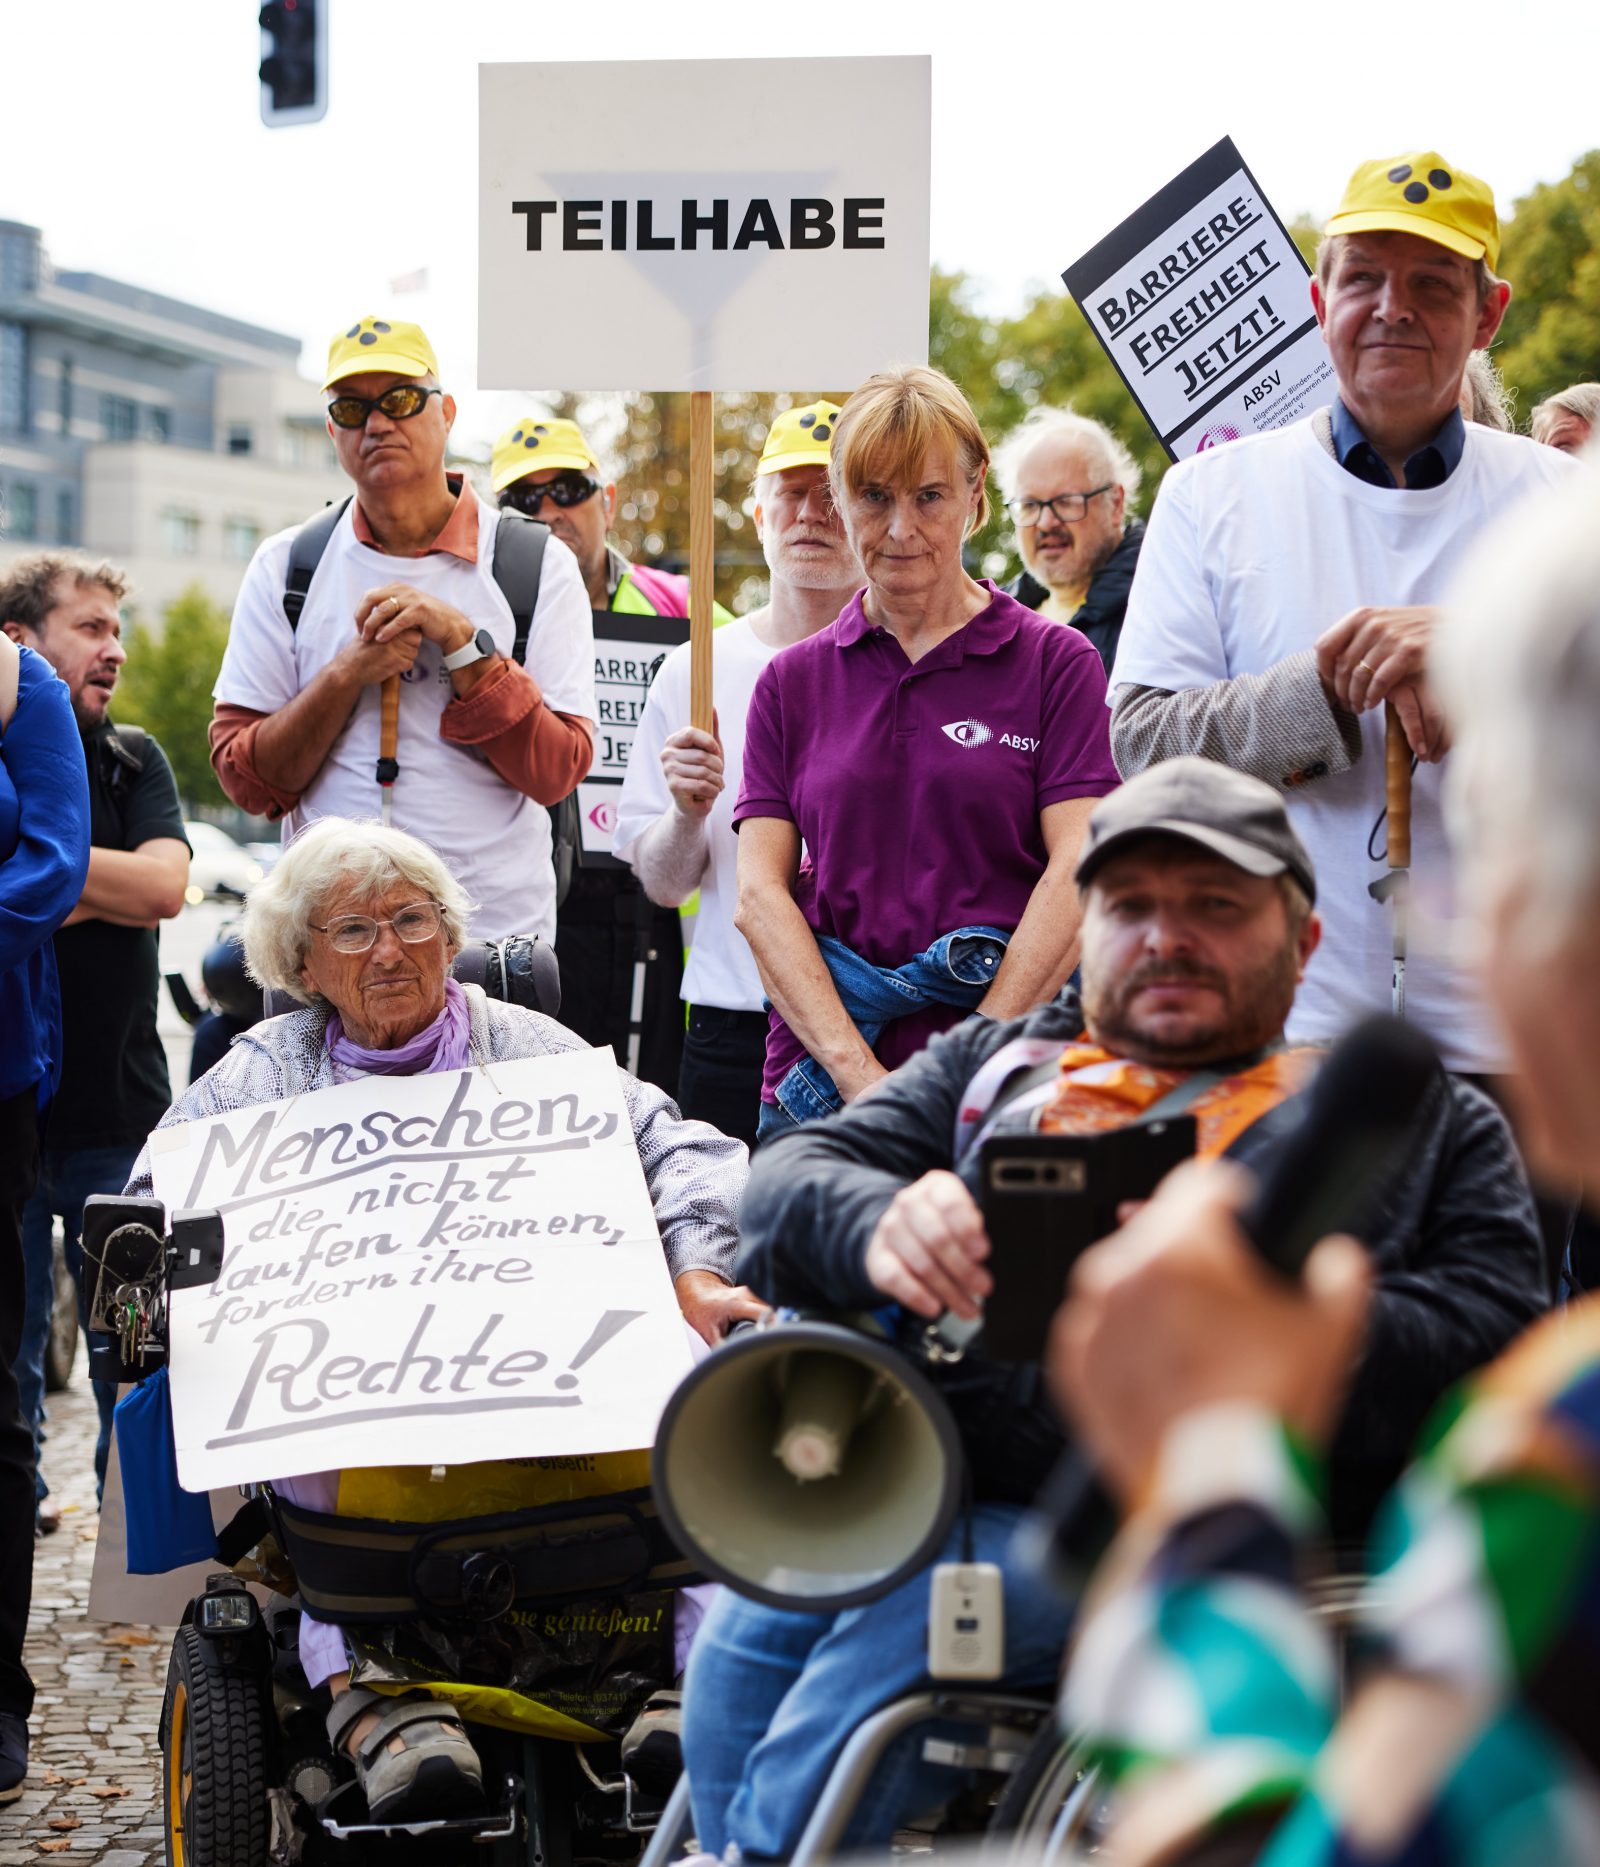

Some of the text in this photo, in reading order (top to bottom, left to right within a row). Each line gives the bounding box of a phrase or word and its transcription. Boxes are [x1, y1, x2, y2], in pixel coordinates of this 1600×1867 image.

[511, 197, 886, 251] TEILHABE
[1097, 196, 1253, 333] BARRIERE-
[1129, 239, 1272, 368] FREIHEIT
[1174, 295, 1280, 396] JETZT!
[1242, 369, 1281, 411] ABSV
[1252, 360, 1328, 424] Allgemeiner Blinden- und
[1256, 366, 1335, 431] Sehbehindertenverein Berl
[1278, 411, 1294, 426] 1874
[595, 658, 650, 682] ARRI
[602, 736, 633, 762] JE
[999, 733, 1041, 753] ABSV
[184, 1071, 618, 1209] Menschen,
[248, 1156, 536, 1243] die nicht
[208, 1200, 626, 1298] laufen können,
[197, 1249, 535, 1344] fordern ihre
[225, 1303, 648, 1431] Rechte!
[544, 1607, 663, 1638] genießen!
